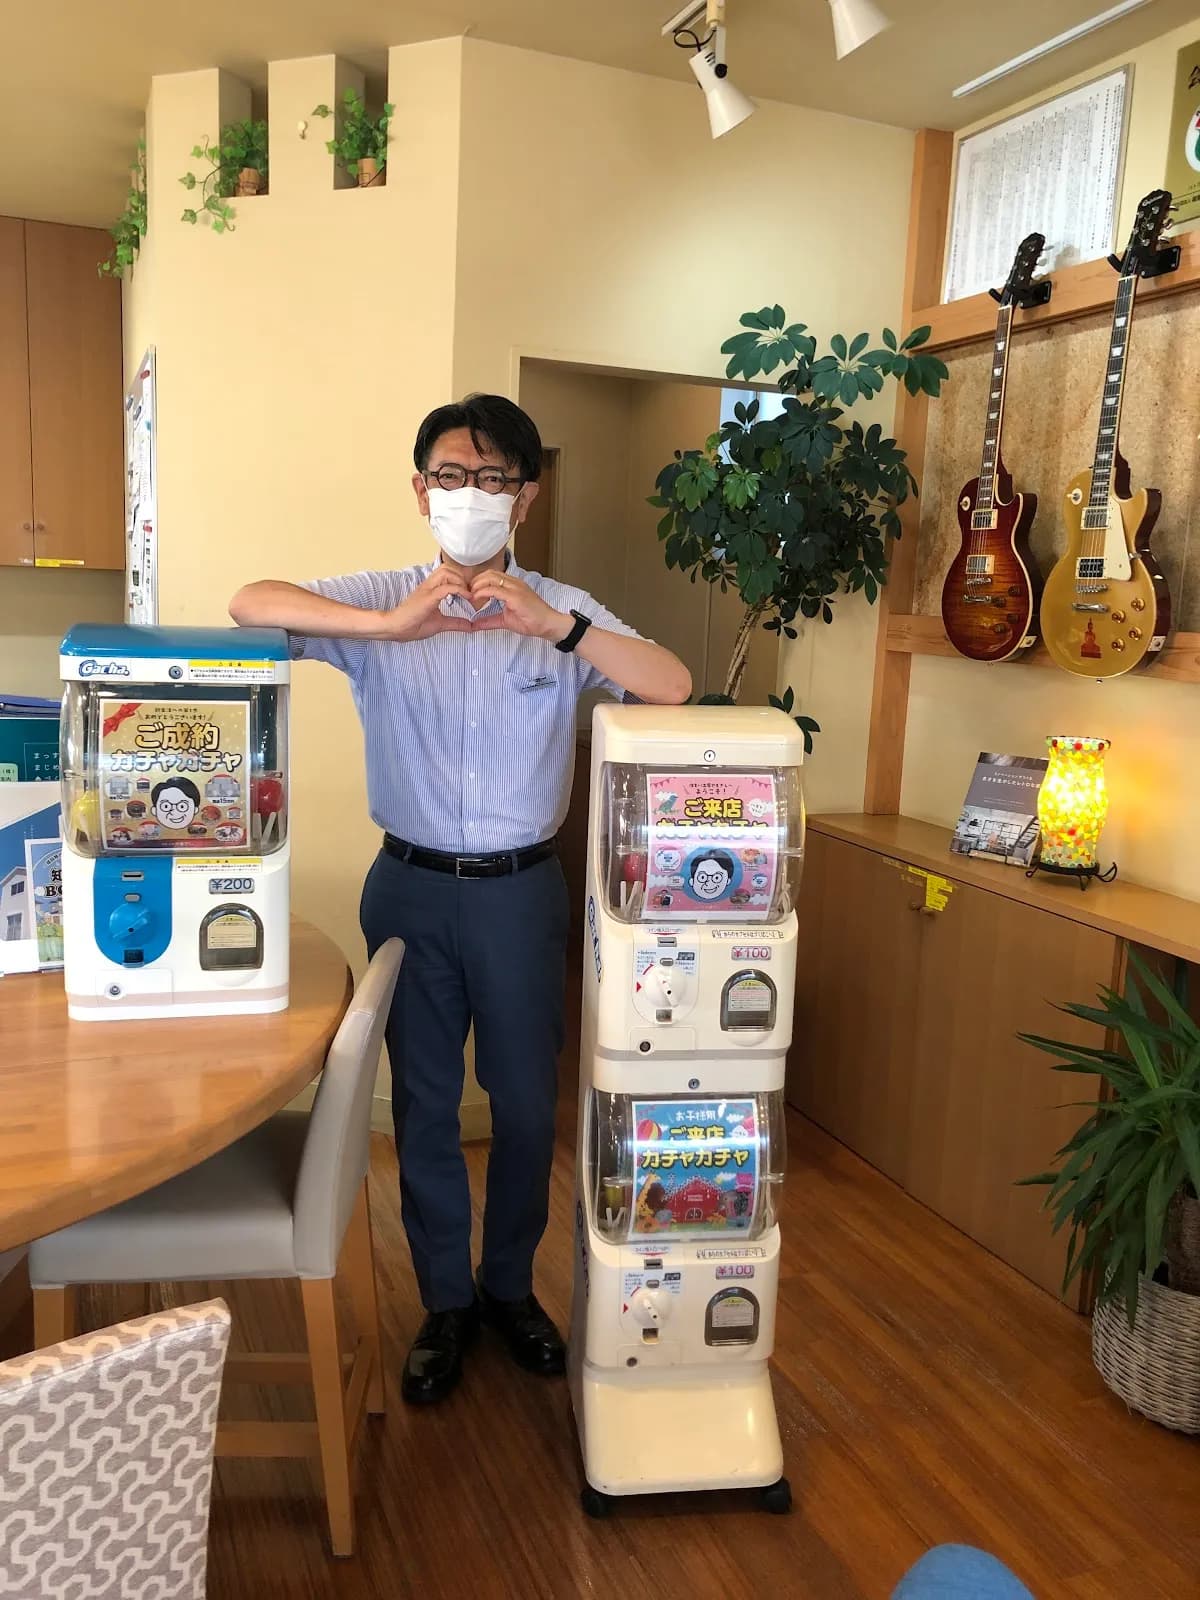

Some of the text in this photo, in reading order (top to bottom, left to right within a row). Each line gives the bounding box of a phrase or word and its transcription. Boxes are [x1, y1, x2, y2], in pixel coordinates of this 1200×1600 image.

[135, 721, 220, 750] ご成約
[111, 749, 242, 772] ガチャガチャ
[684, 797, 743, 818] ご来店
[211, 878, 252, 890] ¥200
[735, 947, 769, 958] ¥100
[718, 1265, 753, 1276] ¥100
